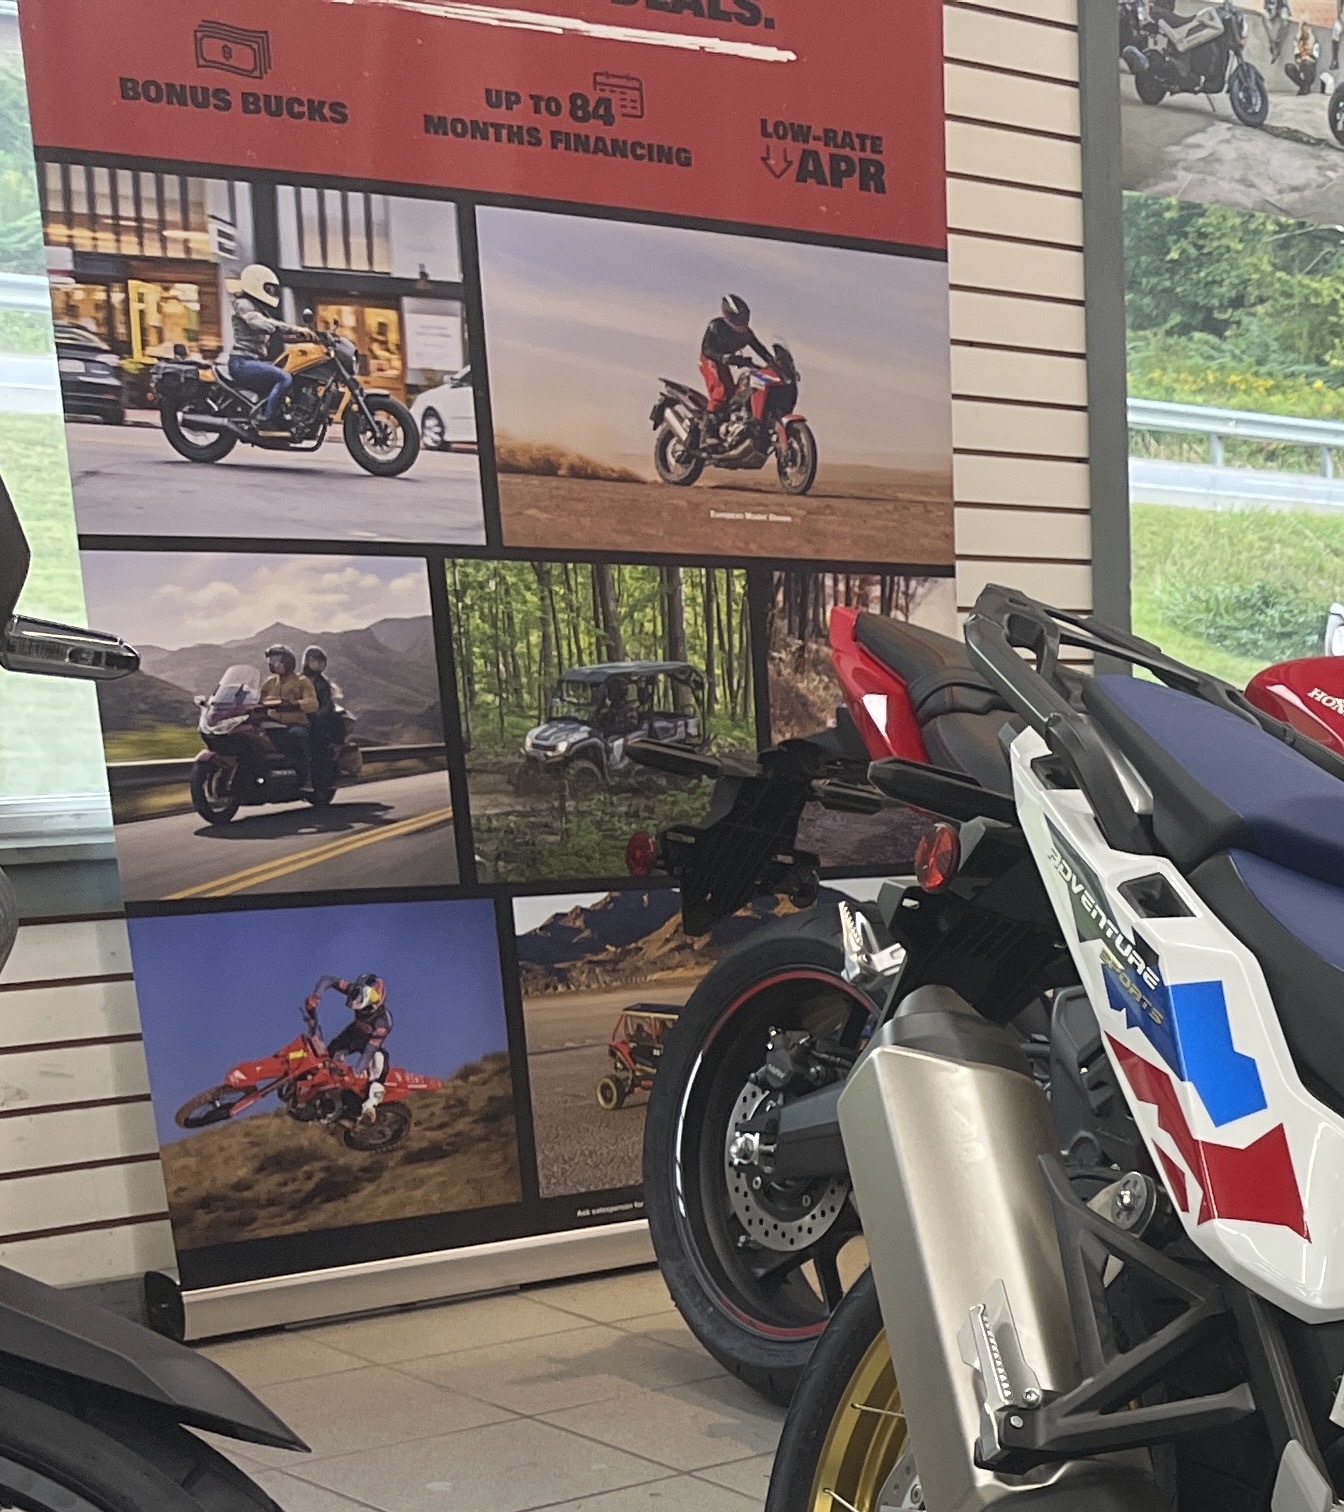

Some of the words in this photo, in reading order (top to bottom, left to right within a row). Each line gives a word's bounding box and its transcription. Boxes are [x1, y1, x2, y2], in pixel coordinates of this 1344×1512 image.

[611, 0, 776, 30] ALS.
[119, 76, 232, 112] BONUS
[241, 91, 349, 125] BUCKS
[484, 87, 522, 111] UP
[529, 93, 563, 117] TO
[567, 92, 616, 127] 84
[423, 113, 543, 148] MONTHS
[550, 130, 693, 168] FINANCING
[760, 118, 884, 155] LOW-RATE
[796, 149, 887, 195] APR
[1047, 847, 1161, 991] ADVENTURE
